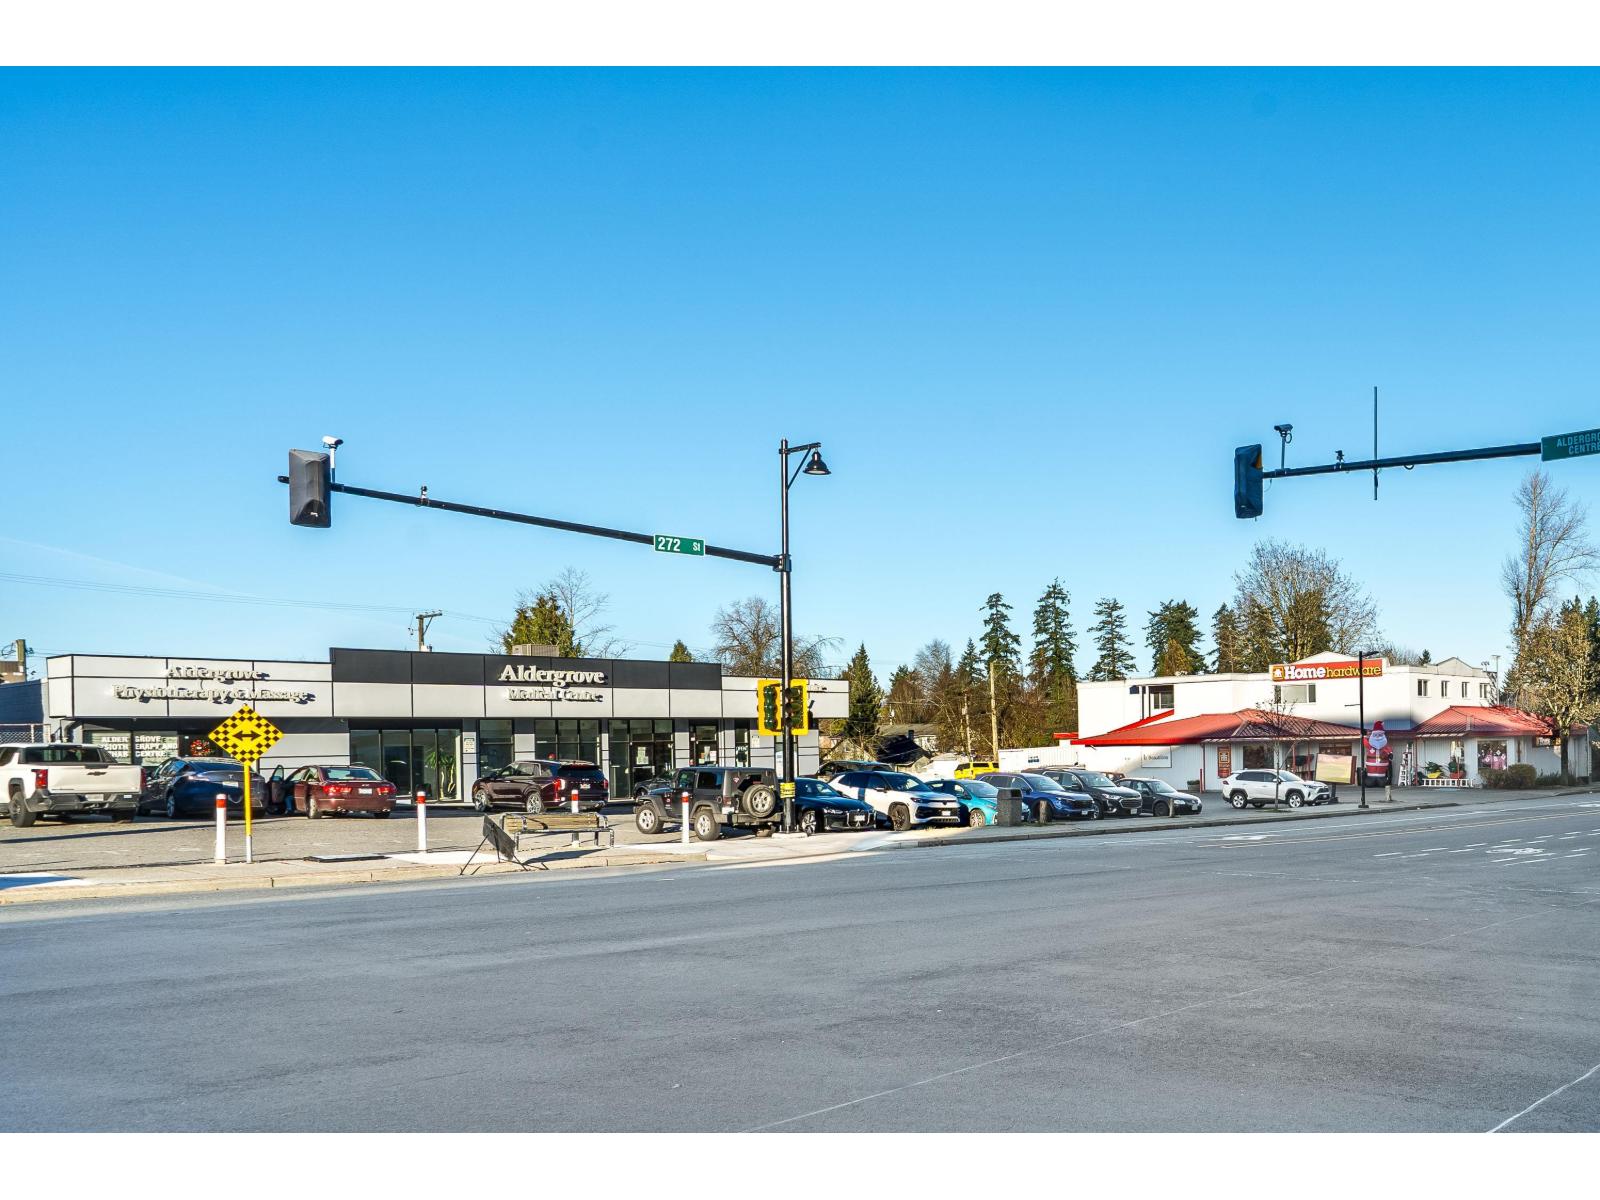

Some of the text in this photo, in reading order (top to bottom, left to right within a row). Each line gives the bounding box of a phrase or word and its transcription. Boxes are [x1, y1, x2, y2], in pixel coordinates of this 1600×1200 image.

[657, 536, 681, 552] 272
[166, 665, 260, 683] Aldergrove
[498, 664, 606, 688] Aldergrove
[1283, 665, 1381, 680] Home hardware
[113, 684, 231, 702] Physiotherapy
[248, 688, 310, 703] Massage
[505, 688, 600, 702] Medical Centre
